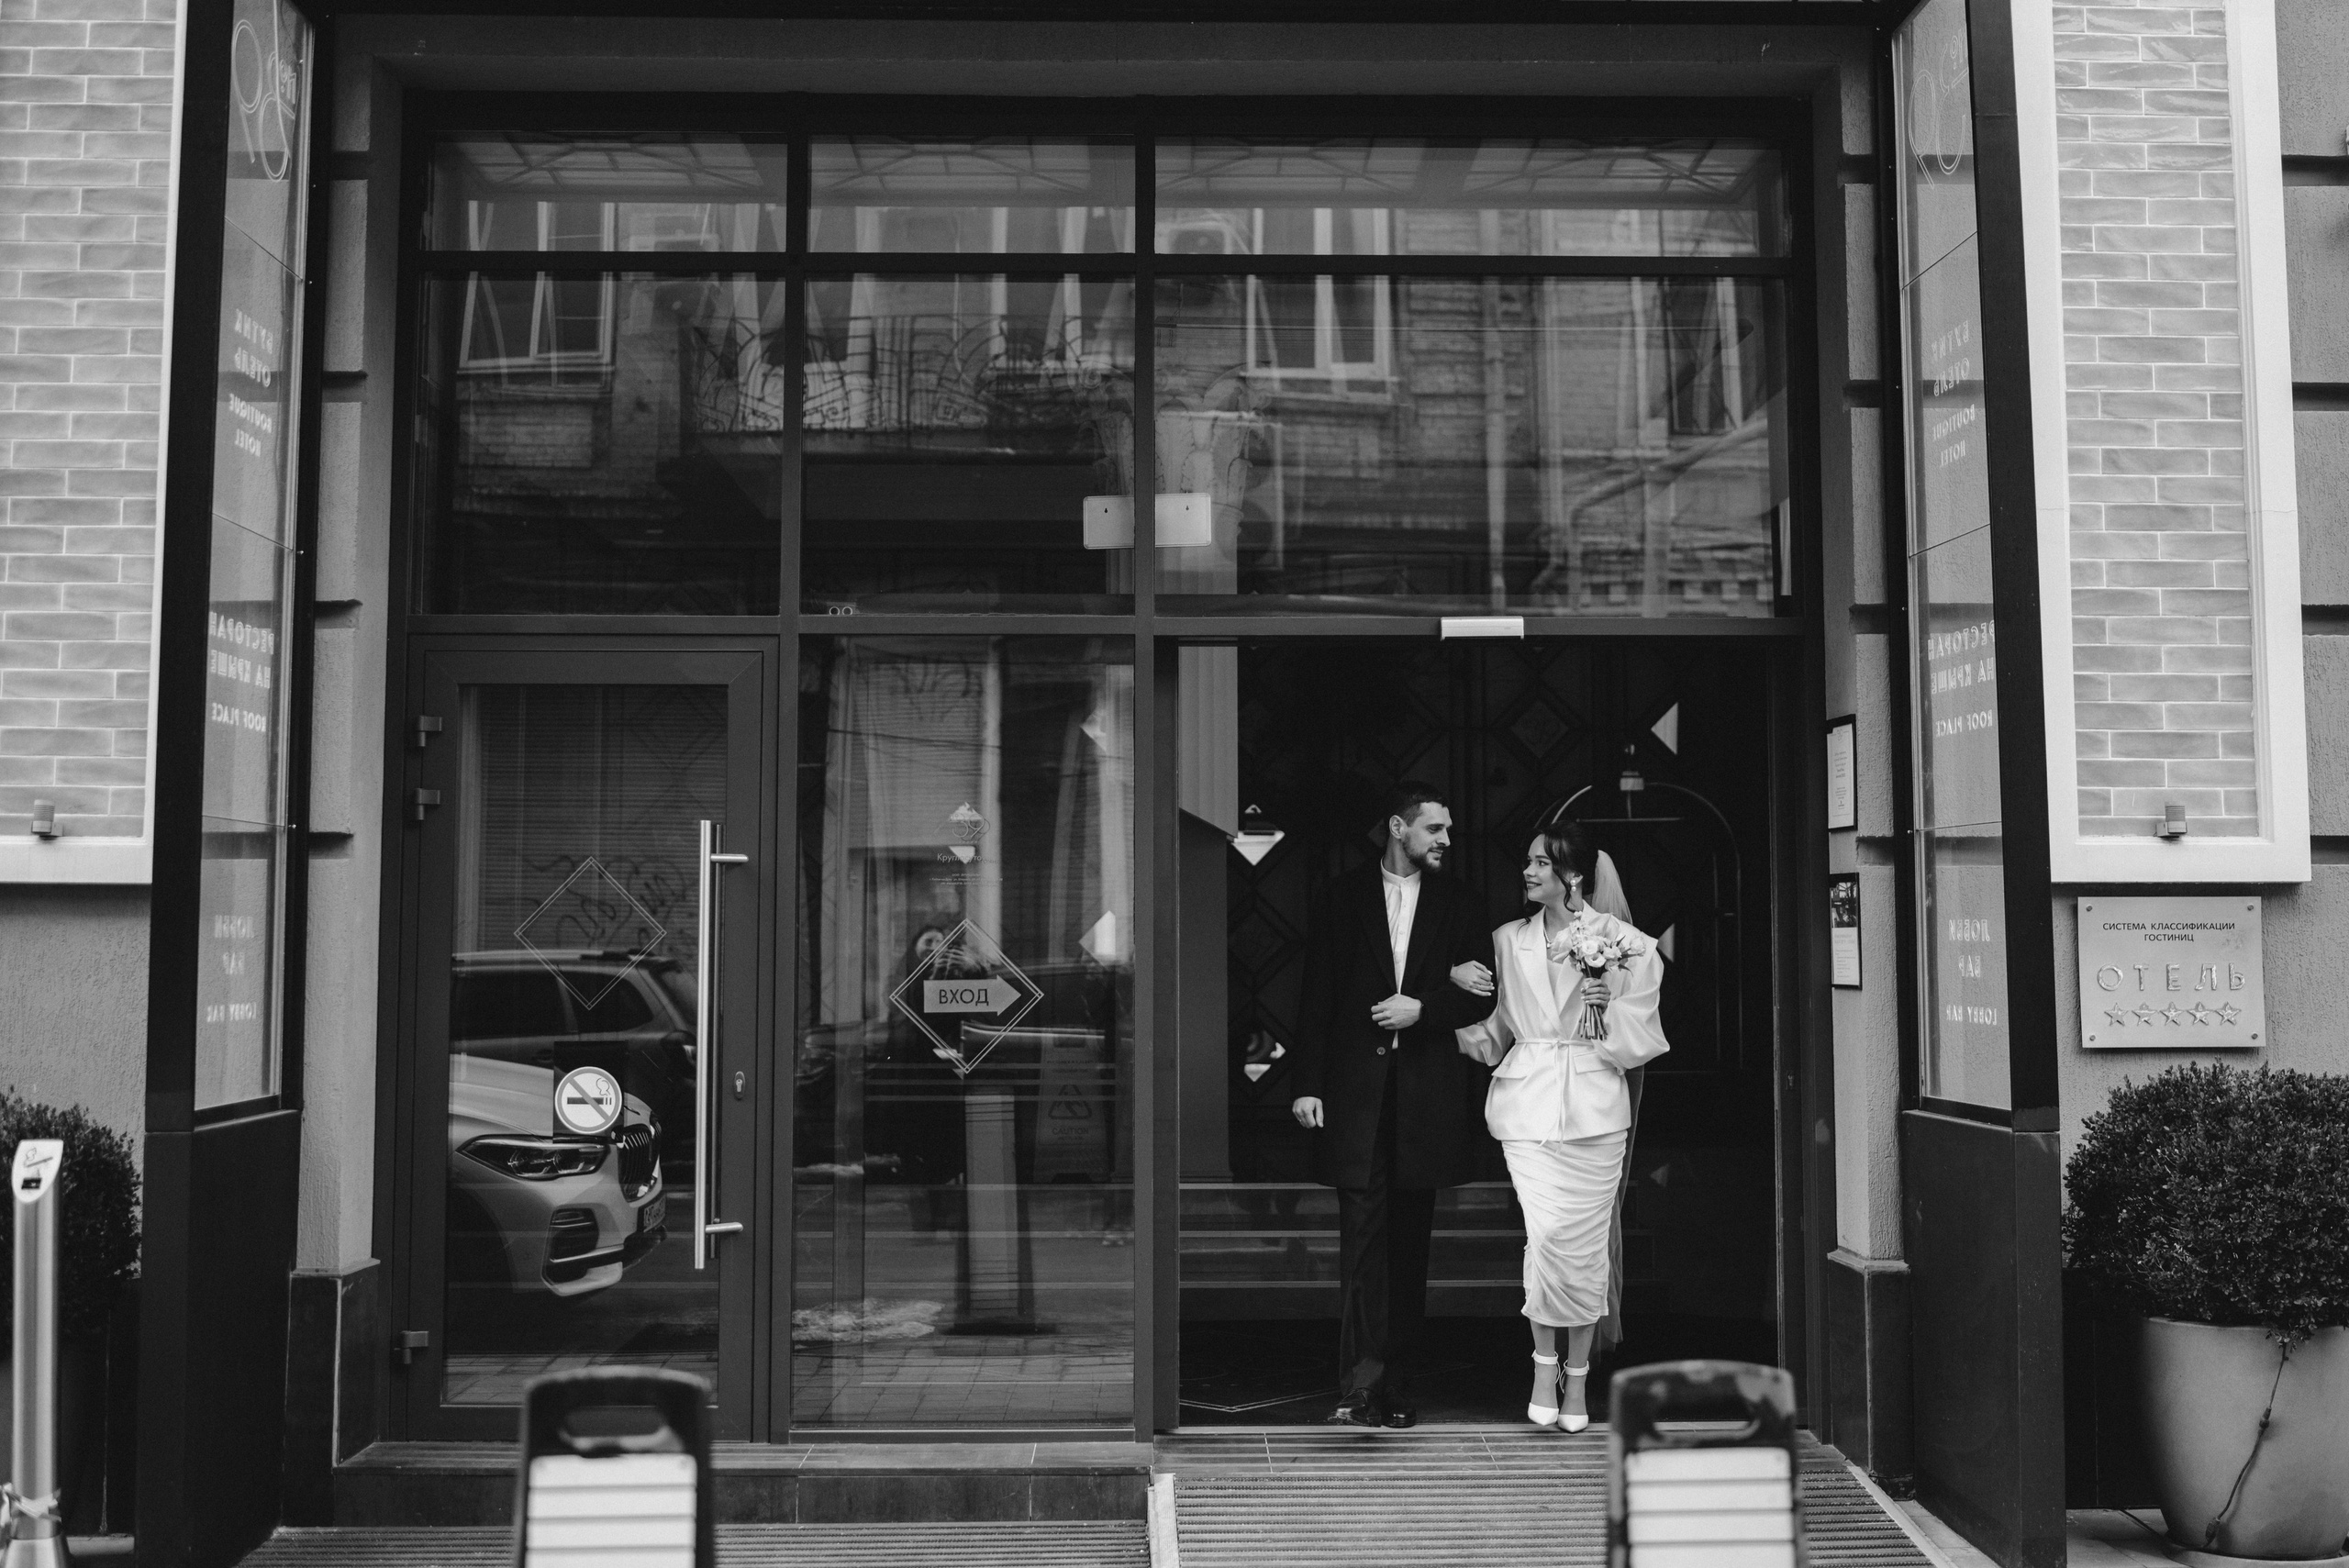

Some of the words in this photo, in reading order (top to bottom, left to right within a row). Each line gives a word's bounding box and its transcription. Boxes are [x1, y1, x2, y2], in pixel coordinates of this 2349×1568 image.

[2102, 922, 2147, 930] СИСТЕМА
[2151, 922, 2235, 932] КЛАССИФИКАЦИИ
[2143, 934, 2194, 942] ГОСТИНИЦ
[2097, 962, 2246, 992] ОТЕЛЬ
[939, 988, 990, 1006] ВХОД
[1052, 1127, 1089, 1136] CAUTION
